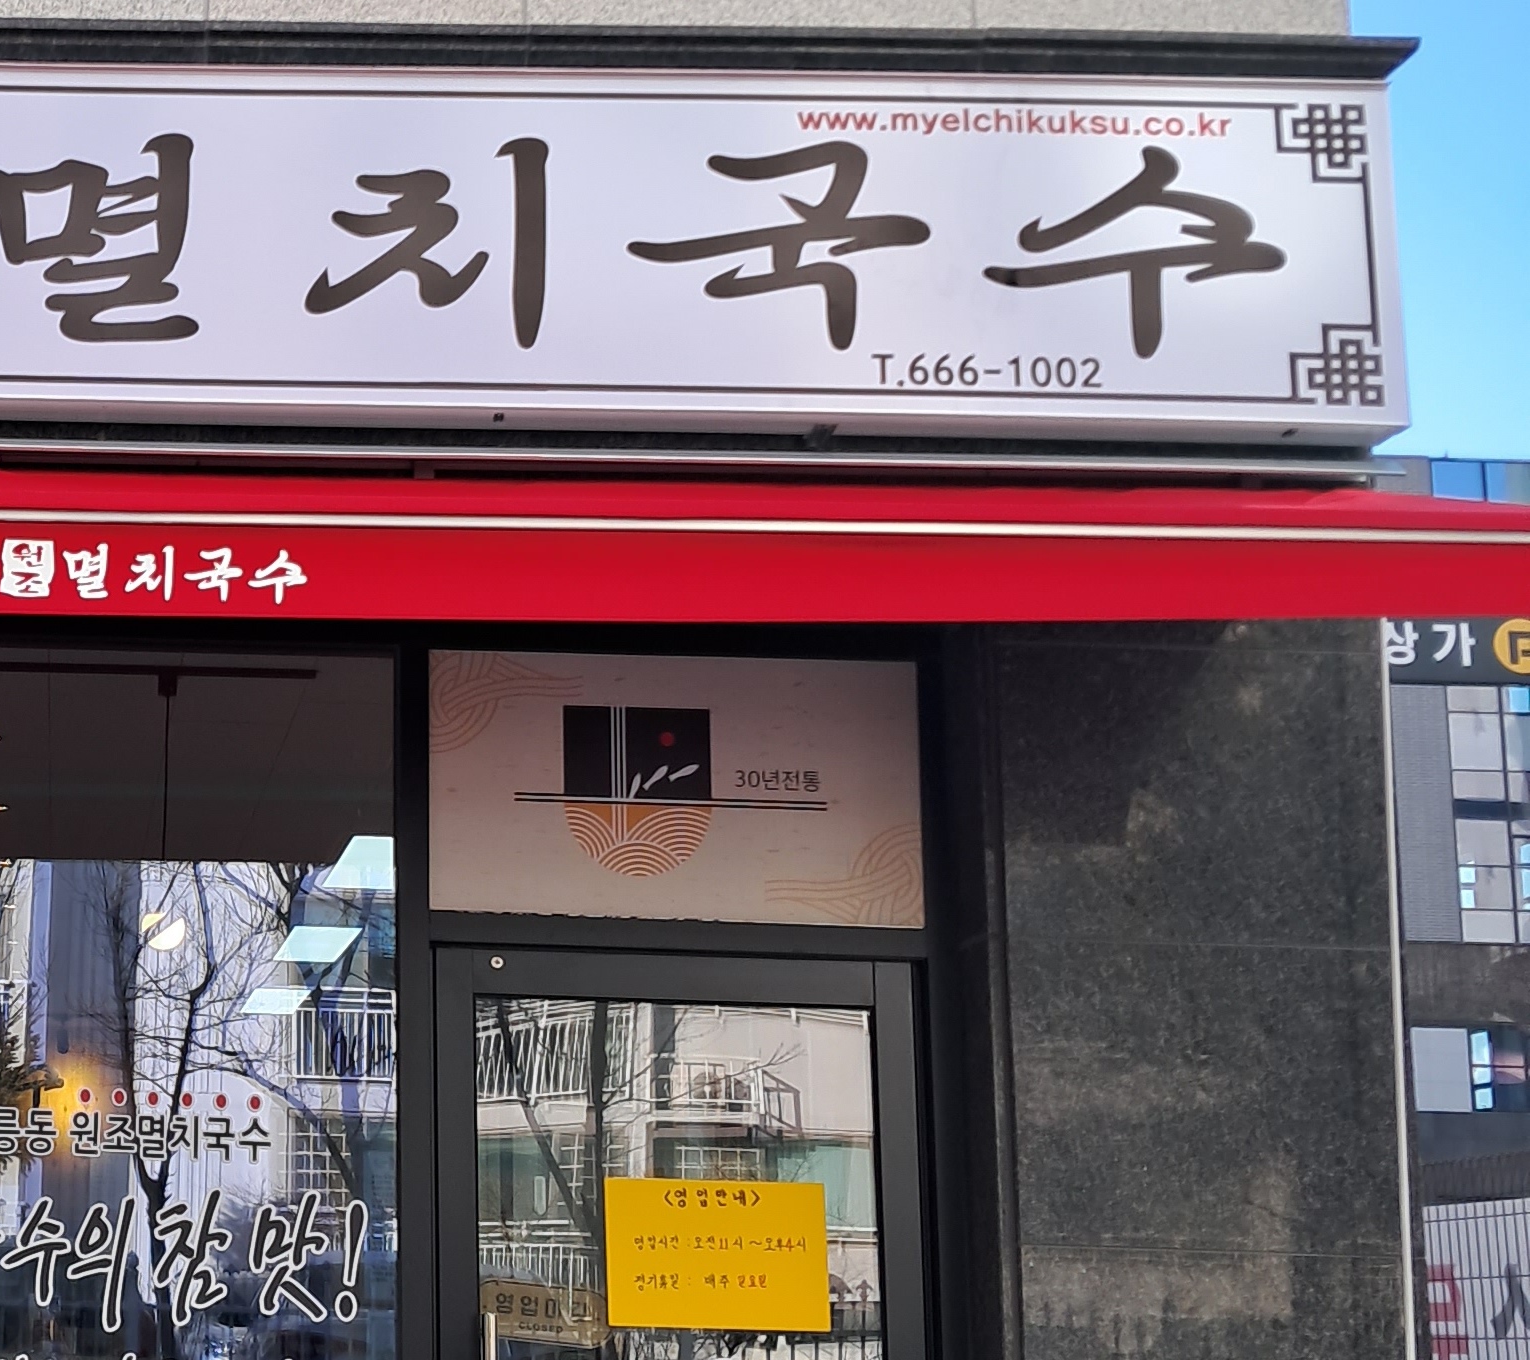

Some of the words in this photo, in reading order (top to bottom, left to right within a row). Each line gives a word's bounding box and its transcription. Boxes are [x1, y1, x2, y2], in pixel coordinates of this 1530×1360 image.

[796, 107, 1233, 138] www.myelchikuksu.co.kr
[871, 353, 1103, 388] T.666-1002
[64, 542, 309, 606] 멸치국수
[734, 769, 821, 793] 30년전통
[518, 1321, 564, 1334] CLOSED
